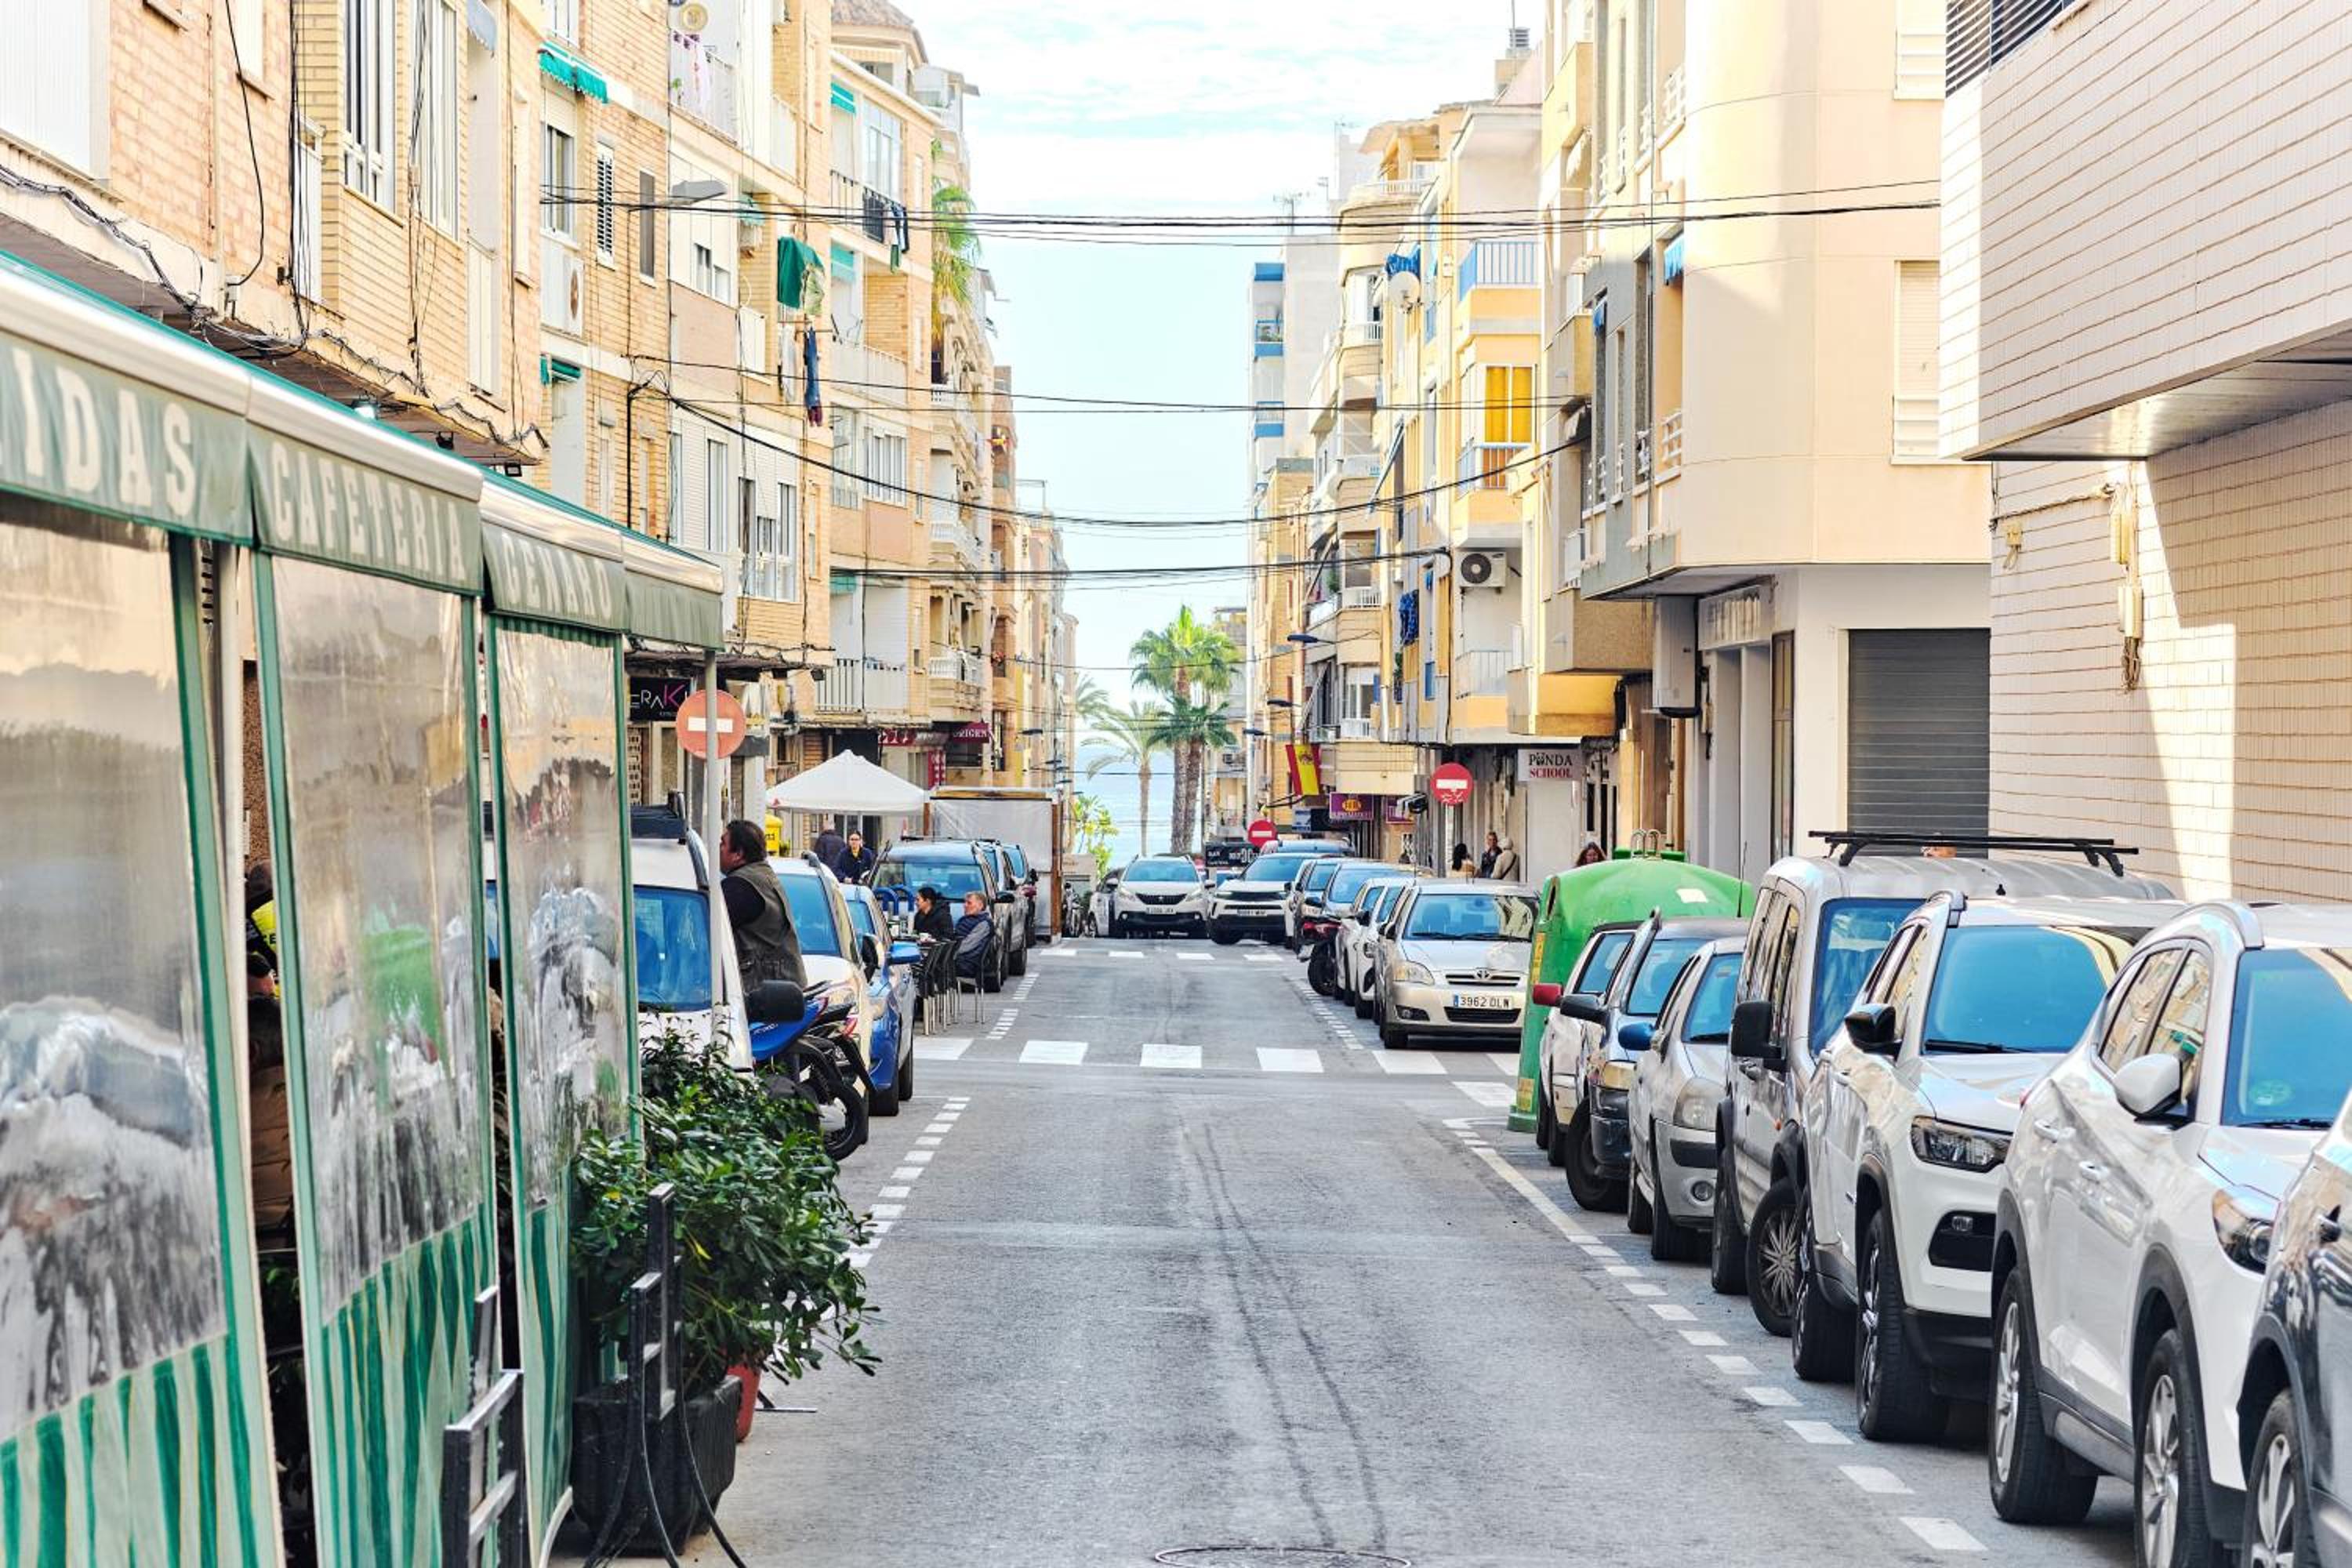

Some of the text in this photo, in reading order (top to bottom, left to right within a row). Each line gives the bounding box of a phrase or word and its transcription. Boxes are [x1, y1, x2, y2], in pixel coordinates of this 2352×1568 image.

[0, 348, 197, 517] IDAS
[271, 441, 467, 581] CAFETERIA
[501, 531, 612, 621] GENARO
[1530, 768, 1573, 779] SCHOOL
[1460, 996, 1487, 1007] 3962
